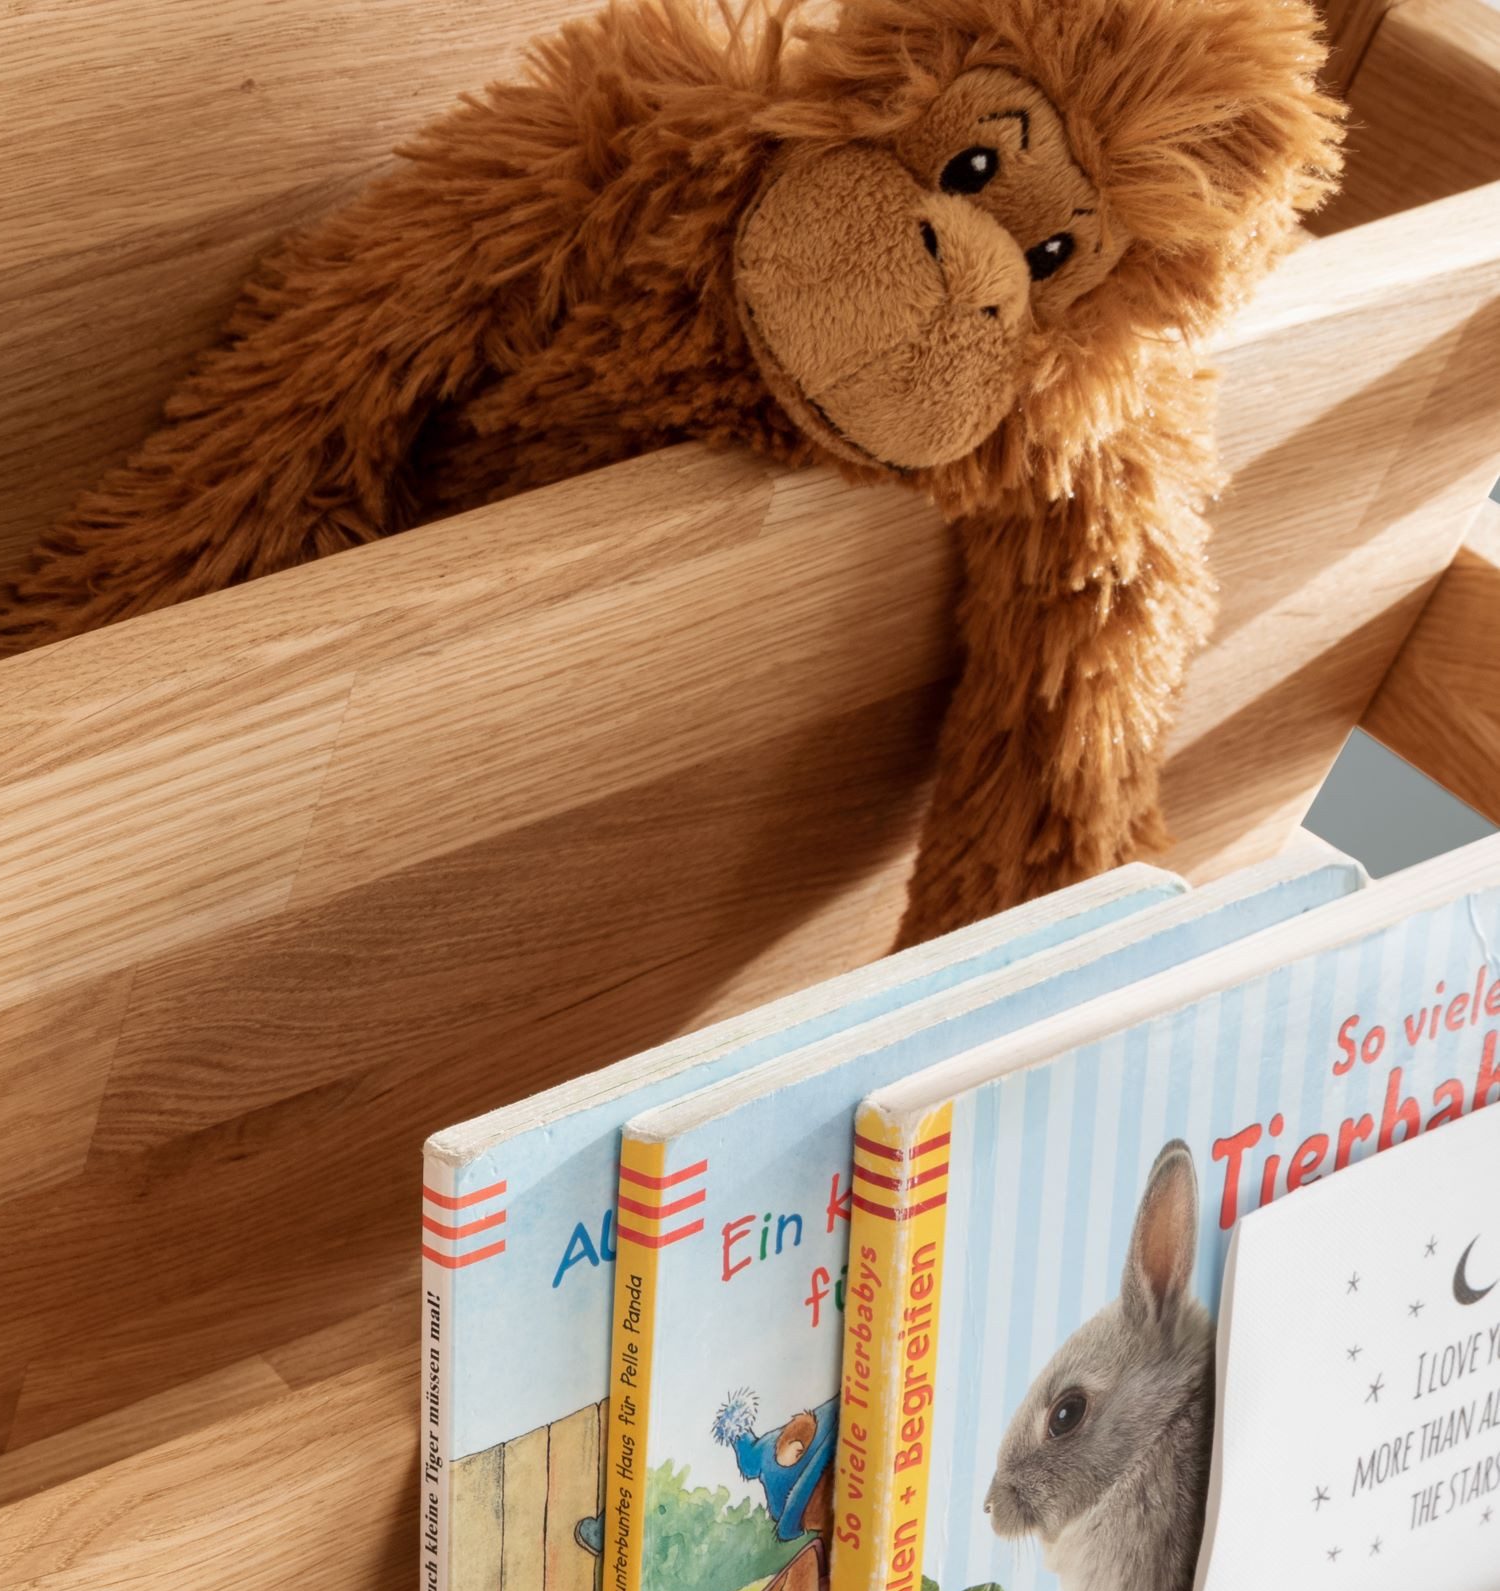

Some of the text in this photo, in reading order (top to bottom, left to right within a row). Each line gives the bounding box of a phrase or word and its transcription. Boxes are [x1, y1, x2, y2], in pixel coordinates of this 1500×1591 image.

[1331, 964, 1500, 1077] So viele
[722, 1212, 803, 1282] Ein
[427, 1290, 441, 1342] mal!
[623, 1273, 643, 1335] Panda
[426, 1347, 441, 1427] müssen
[620, 1342, 639, 1389] Pelle
[894, 1240, 938, 1476] Begreifen
[1413, 1322, 1500, 1400] I LOVE Y
[618, 1396, 637, 1426] für
[836, 1243, 883, 1551] So viele Tierbabys
[425, 1430, 444, 1485] Tiger
[616, 1434, 636, 1481] Haus
[1351, 1430, 1415, 1498] MORE
[1419, 1400, 1477, 1463] THAN
[425, 1492, 440, 1556] kleine
[1410, 1480, 1445, 1531] THE
